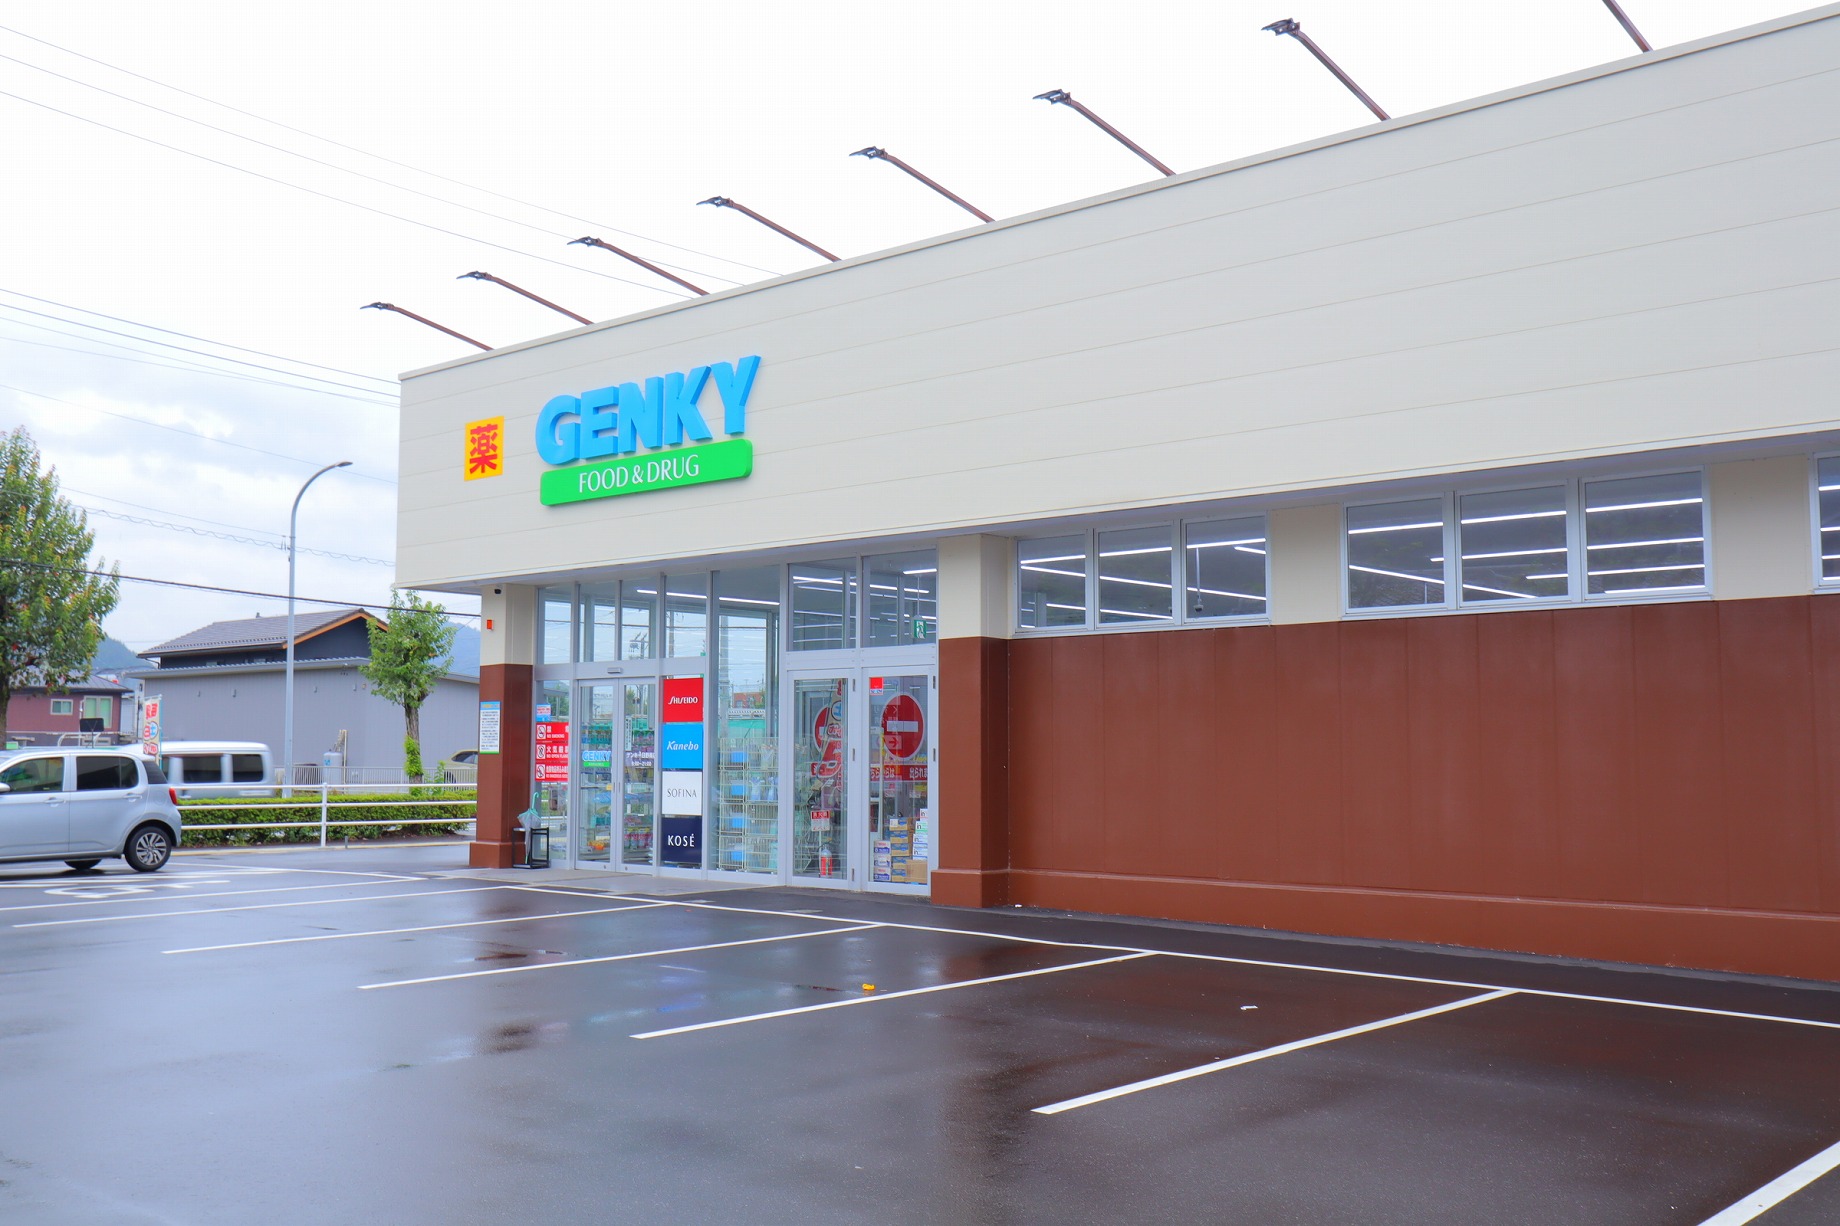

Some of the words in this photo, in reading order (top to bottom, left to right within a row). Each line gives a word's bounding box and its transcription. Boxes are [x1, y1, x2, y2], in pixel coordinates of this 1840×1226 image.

[535, 355, 761, 465] GENKY
[469, 423, 498, 474] 薬
[668, 696, 698, 704] SHISEIDO
[667, 741, 699, 751] Kanebo
[582, 751, 612, 762] GENKY
[667, 788, 697, 798] SOFINA
[667, 833, 695, 847] KOSÉ
